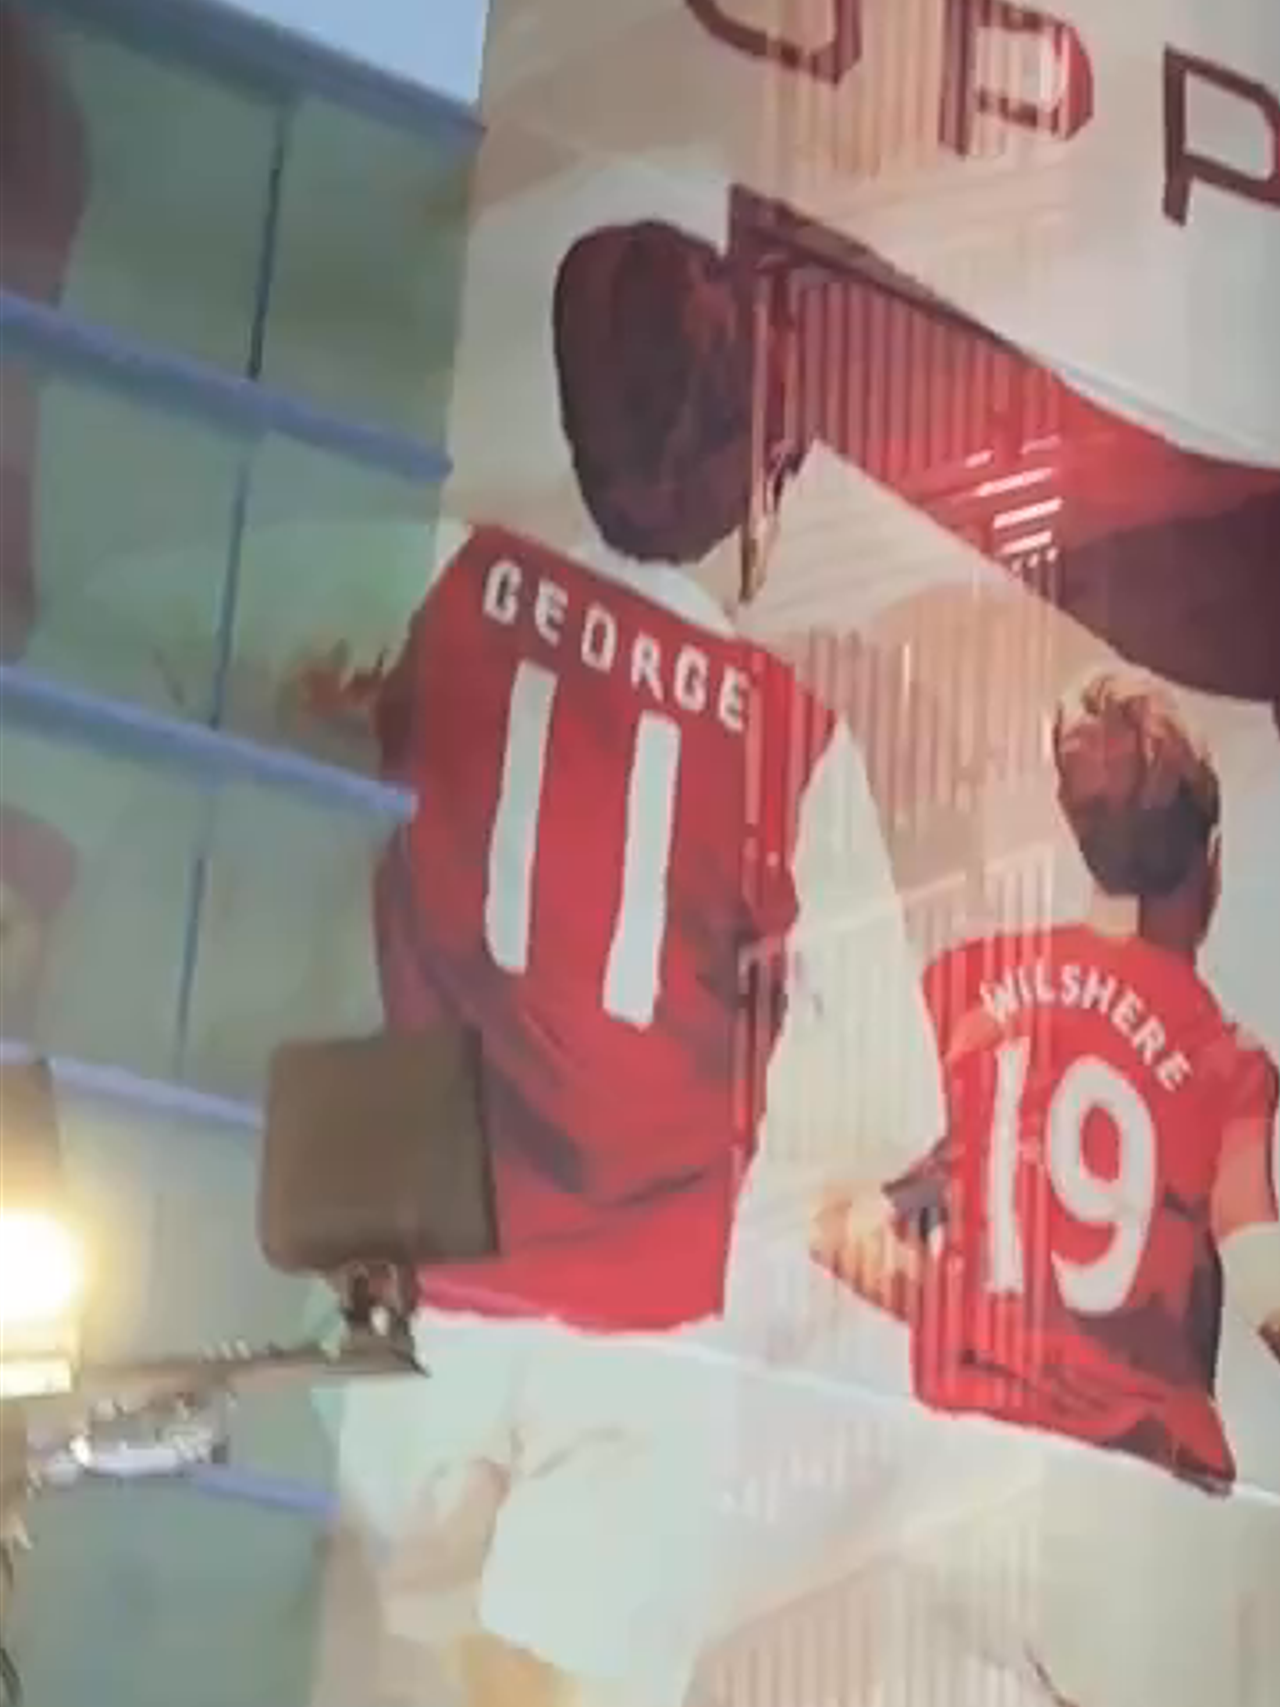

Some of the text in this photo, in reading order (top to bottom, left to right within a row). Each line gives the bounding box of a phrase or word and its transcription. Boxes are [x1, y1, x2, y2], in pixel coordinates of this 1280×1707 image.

[482, 559, 754, 733] GEORGE
[485, 659, 682, 1031] 11
[979, 961, 1192, 1092] WILSHERE
[980, 1036, 1159, 1316] 19
